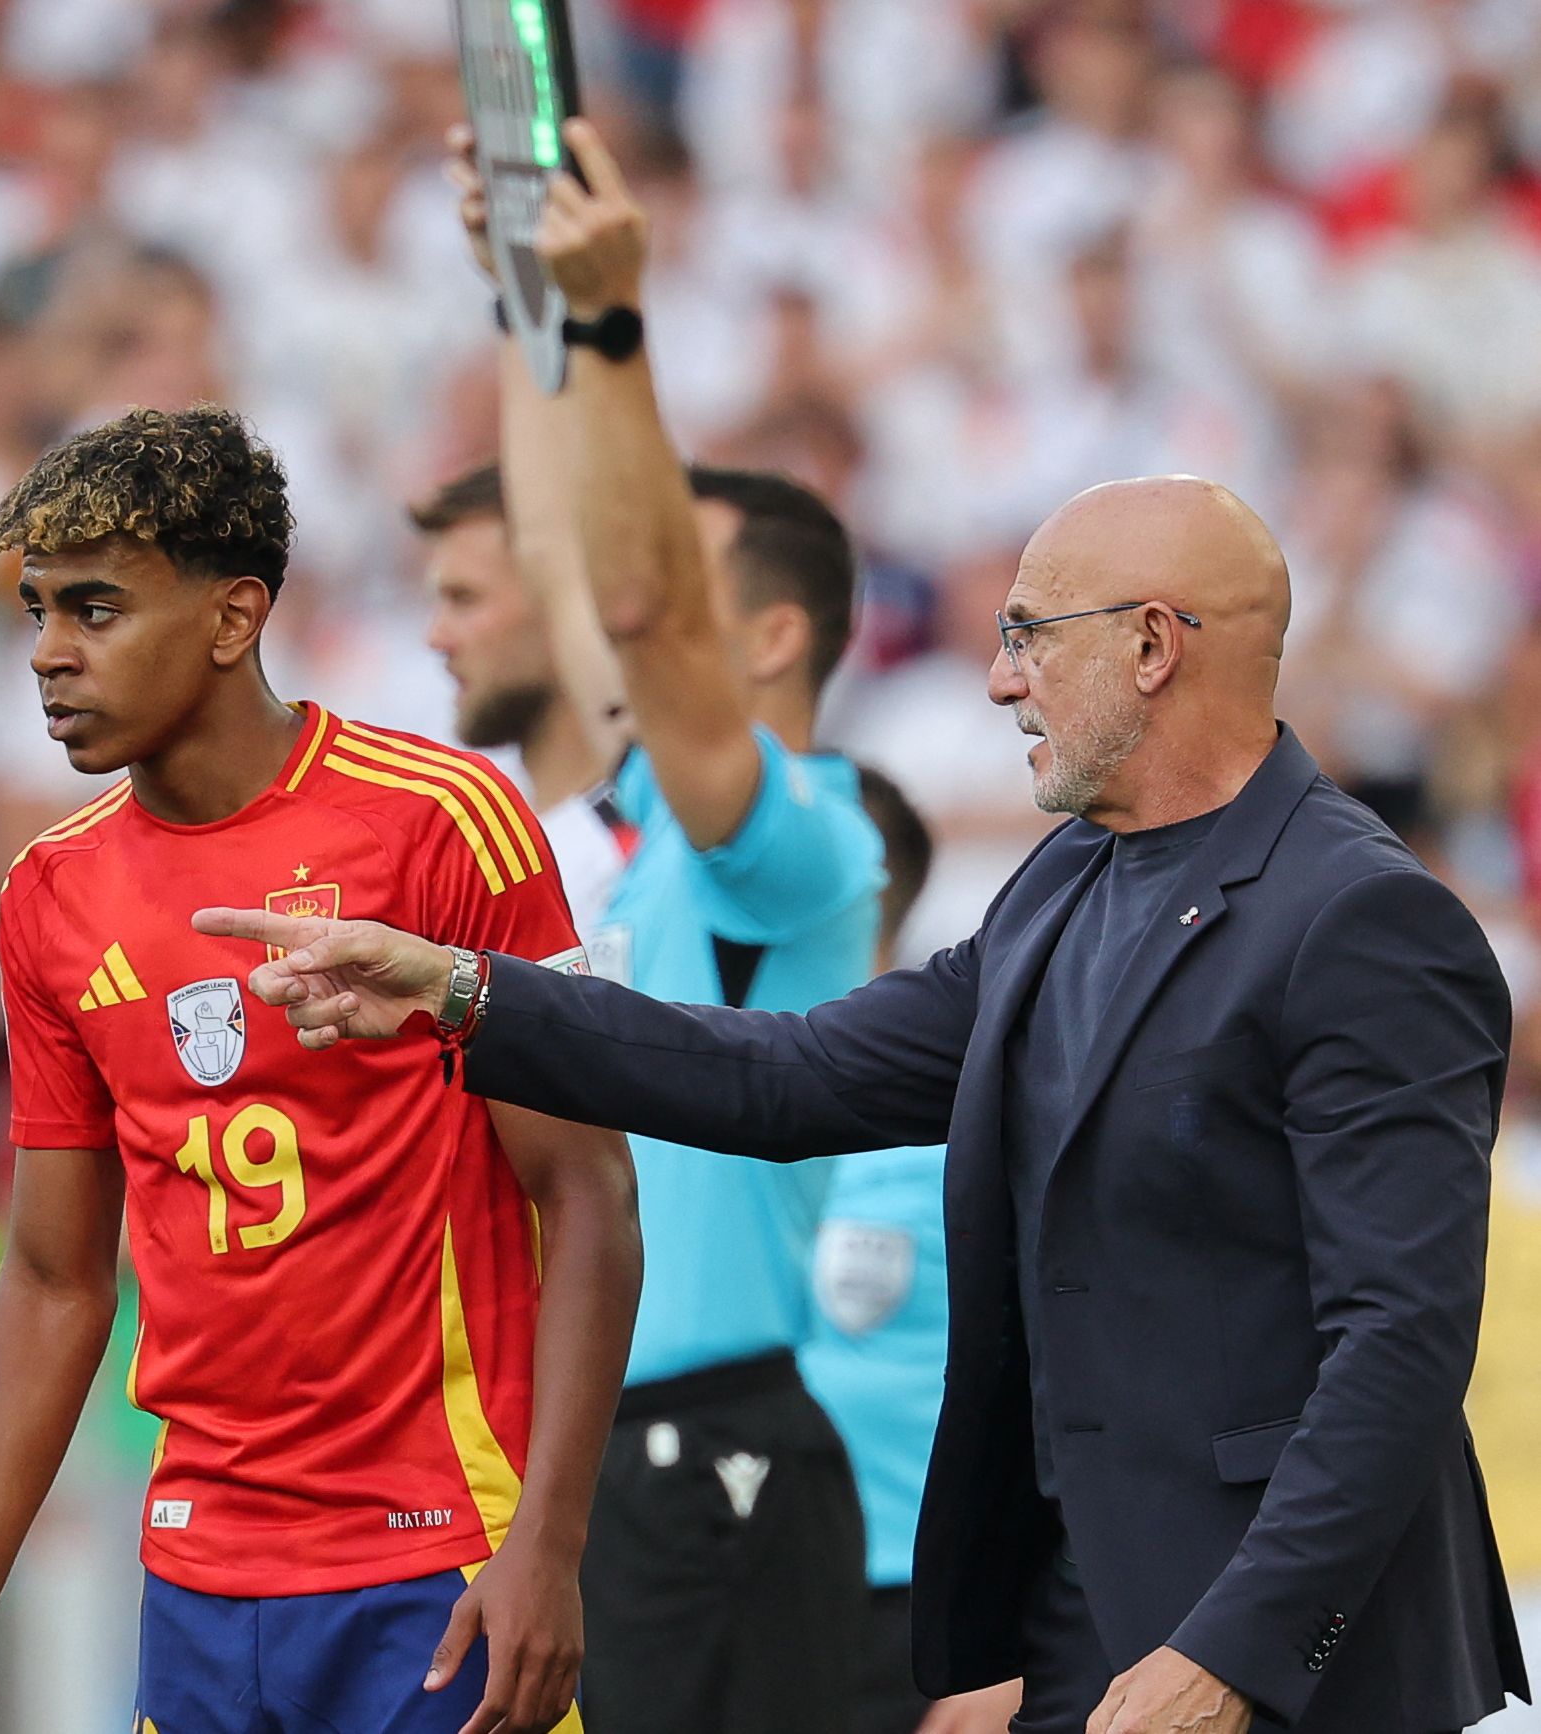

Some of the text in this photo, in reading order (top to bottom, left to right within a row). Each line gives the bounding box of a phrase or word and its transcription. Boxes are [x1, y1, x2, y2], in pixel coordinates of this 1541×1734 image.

[171, 981, 233, 1003] UEFA NATIONS LEAGUE
[175, 1103, 306, 1255] 19
[388, 1509, 452, 1529] HEAT.RDY
